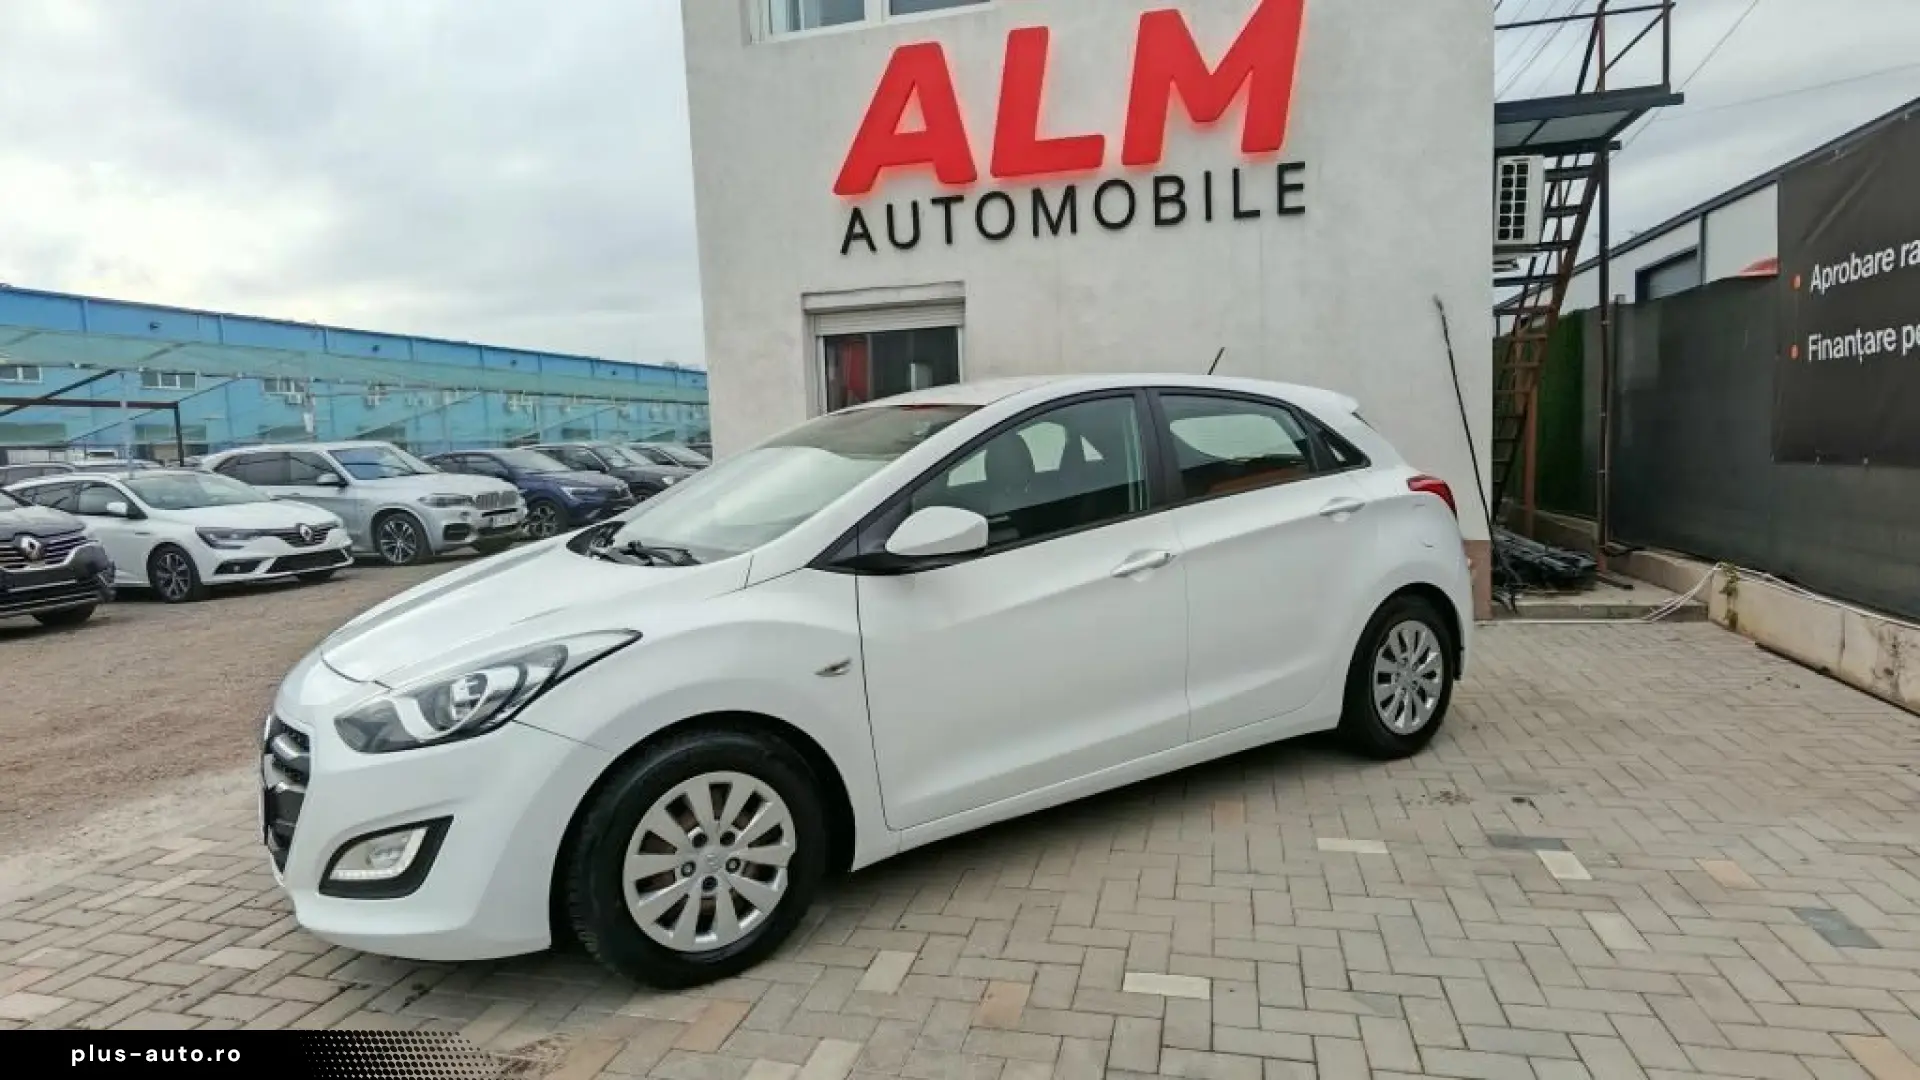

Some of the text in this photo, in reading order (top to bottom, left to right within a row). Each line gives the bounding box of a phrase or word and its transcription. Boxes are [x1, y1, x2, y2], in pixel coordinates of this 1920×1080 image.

[834, 0, 1304, 195] ALM
[841, 162, 1306, 254] AUTOMOBILE
[1810, 247, 1895, 295] Aprobare
